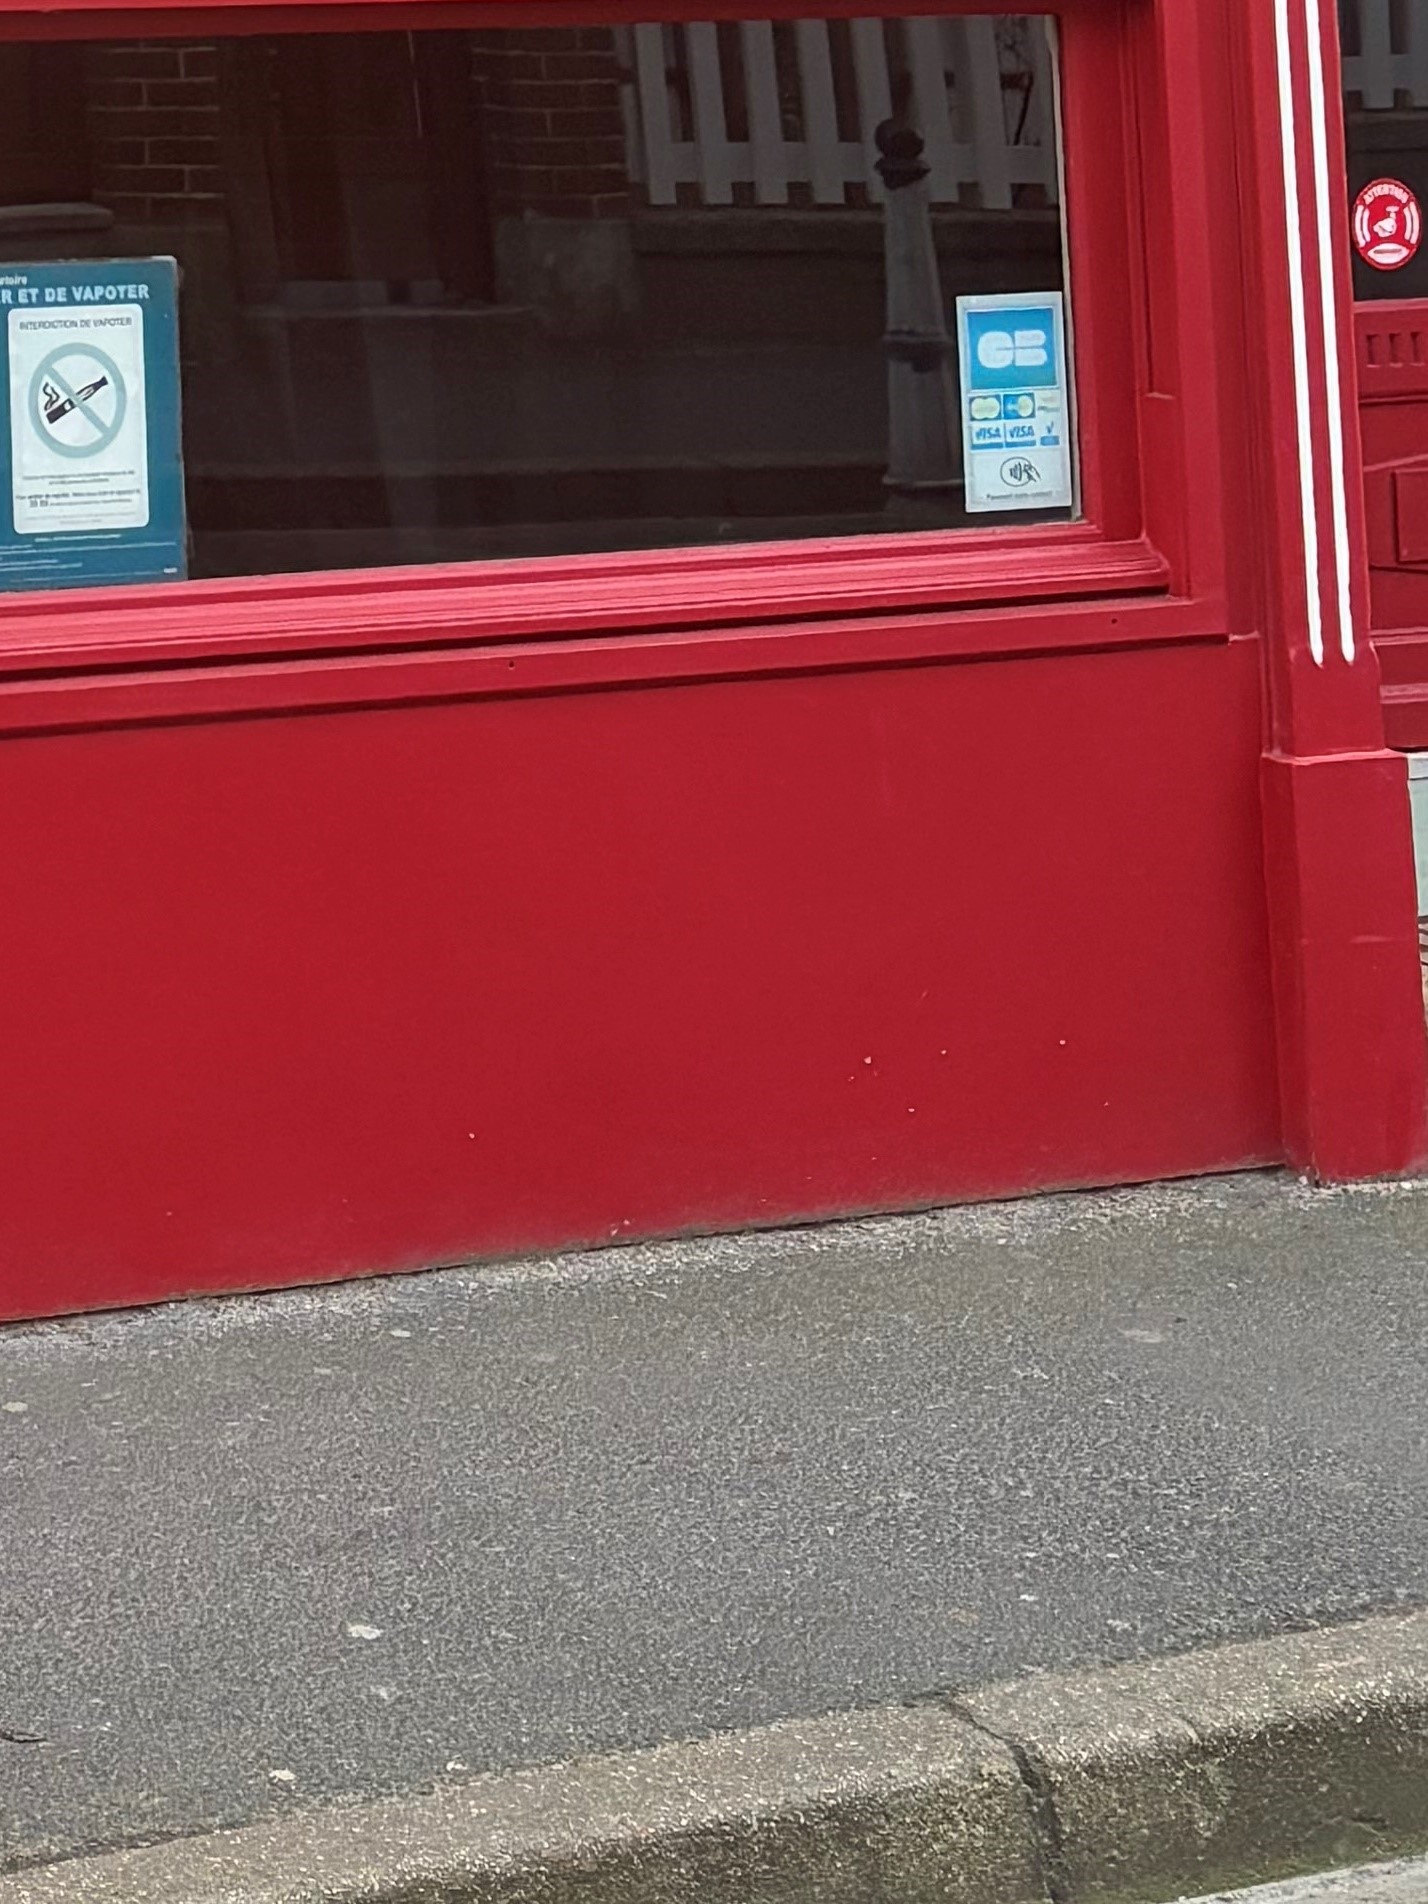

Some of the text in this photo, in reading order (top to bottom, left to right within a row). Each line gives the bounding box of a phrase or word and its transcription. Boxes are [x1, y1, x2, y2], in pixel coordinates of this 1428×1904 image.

[18, 288, 38, 304] ET
[44, 287, 67, 303] DE
[71, 284, 150, 301] VAPOTER
[977, 329, 1048, 368] CB
[1009, 425, 1035, 439] VISA
